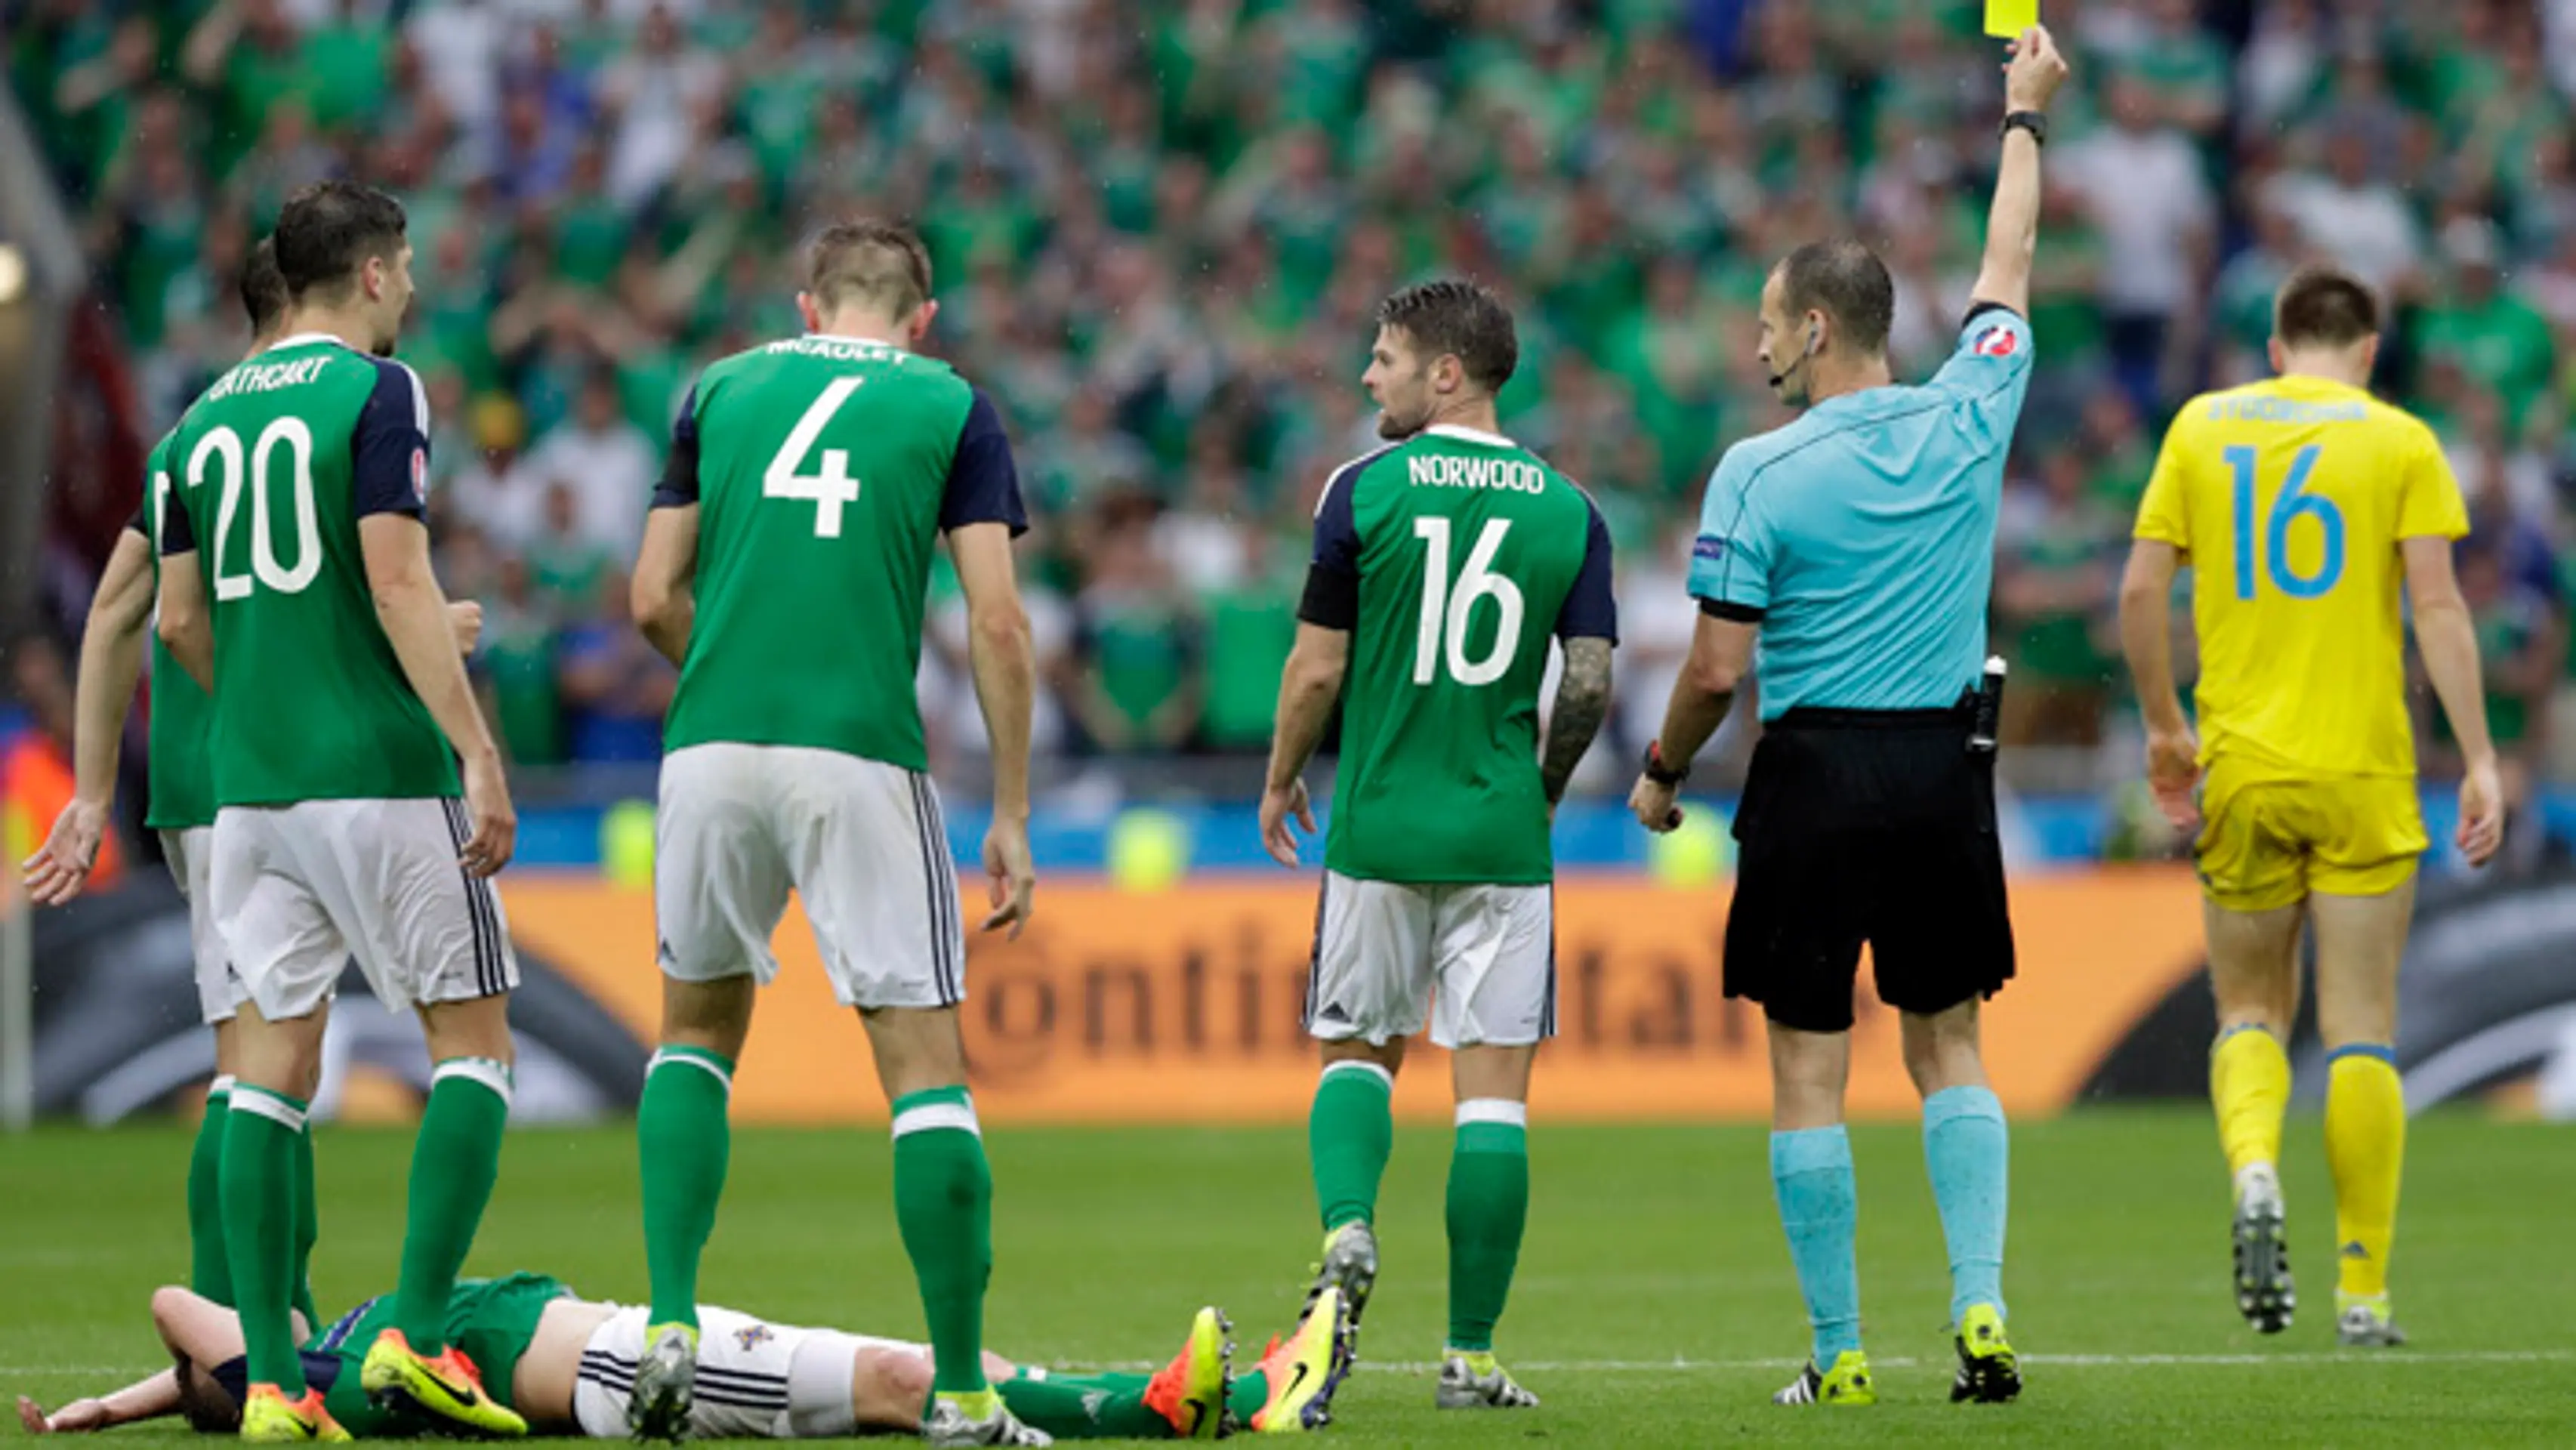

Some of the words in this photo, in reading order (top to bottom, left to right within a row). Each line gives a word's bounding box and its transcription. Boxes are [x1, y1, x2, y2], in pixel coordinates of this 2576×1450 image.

[187, 417, 322, 600] 20
[763, 376, 864, 537] 4
[1408, 455, 1544, 494] NORWOOD
[2223, 443, 2346, 600] 16
[1413, 516, 1524, 684] 16
